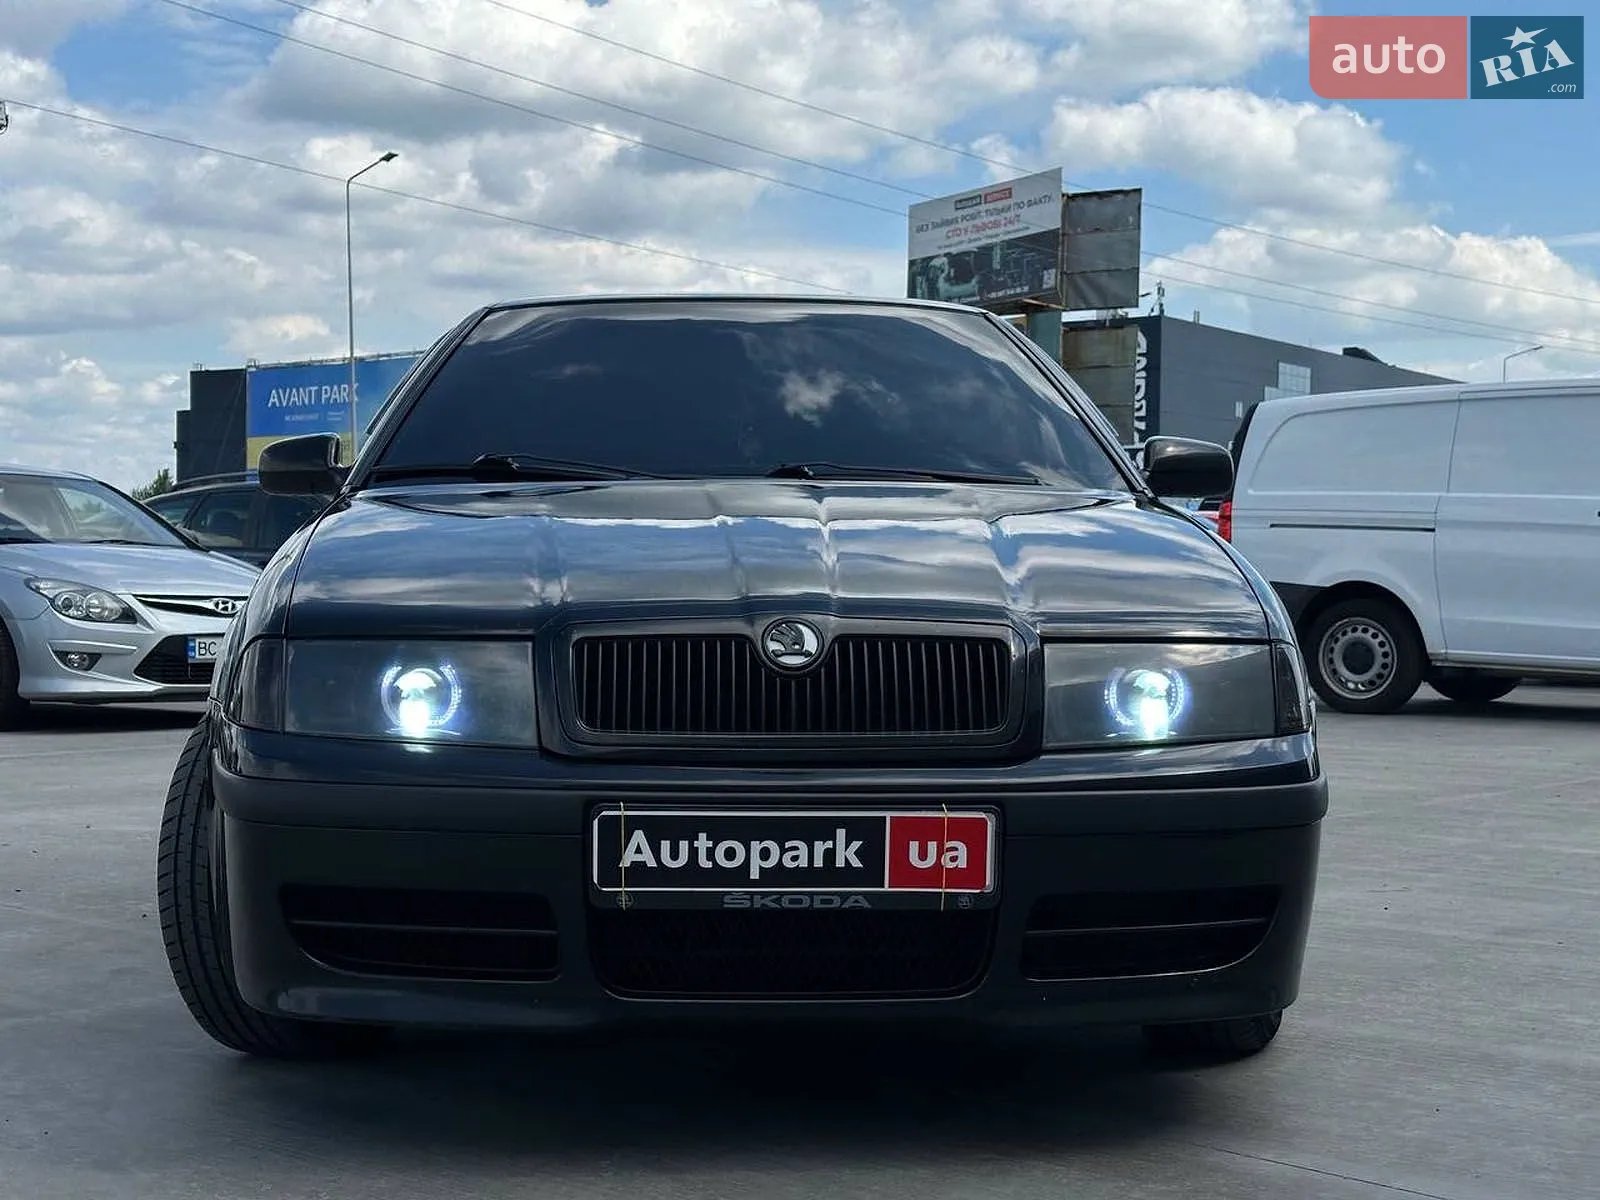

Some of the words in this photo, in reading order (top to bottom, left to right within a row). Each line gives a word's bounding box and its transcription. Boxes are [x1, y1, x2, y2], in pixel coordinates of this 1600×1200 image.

[268, 387, 318, 408] AVANT
[322, 382, 360, 404] PARK
[198, 641, 217, 656] BC
[619, 828, 864, 879] Autopark
[908, 840, 969, 869] ua
